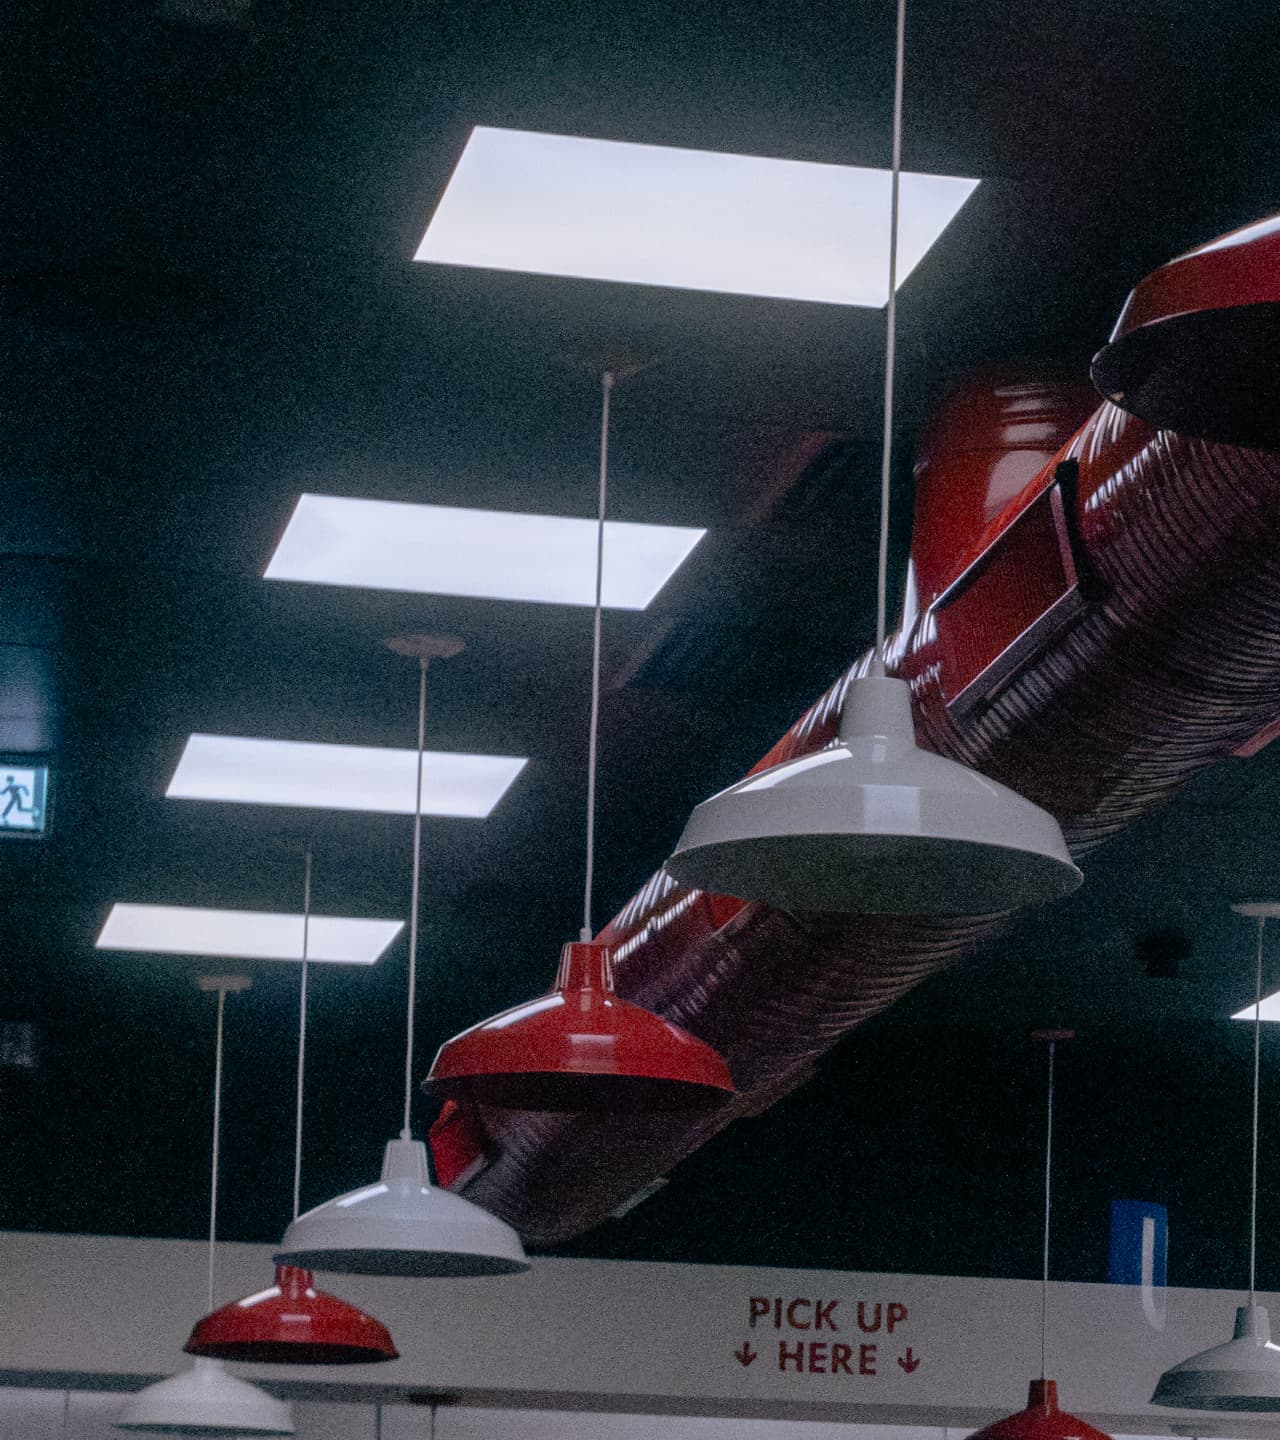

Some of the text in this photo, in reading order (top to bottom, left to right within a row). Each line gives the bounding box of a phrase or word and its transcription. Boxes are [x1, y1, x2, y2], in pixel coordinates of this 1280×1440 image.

[749, 1297, 909, 1333] PICK UP
[779, 1341, 877, 1375] HERE
